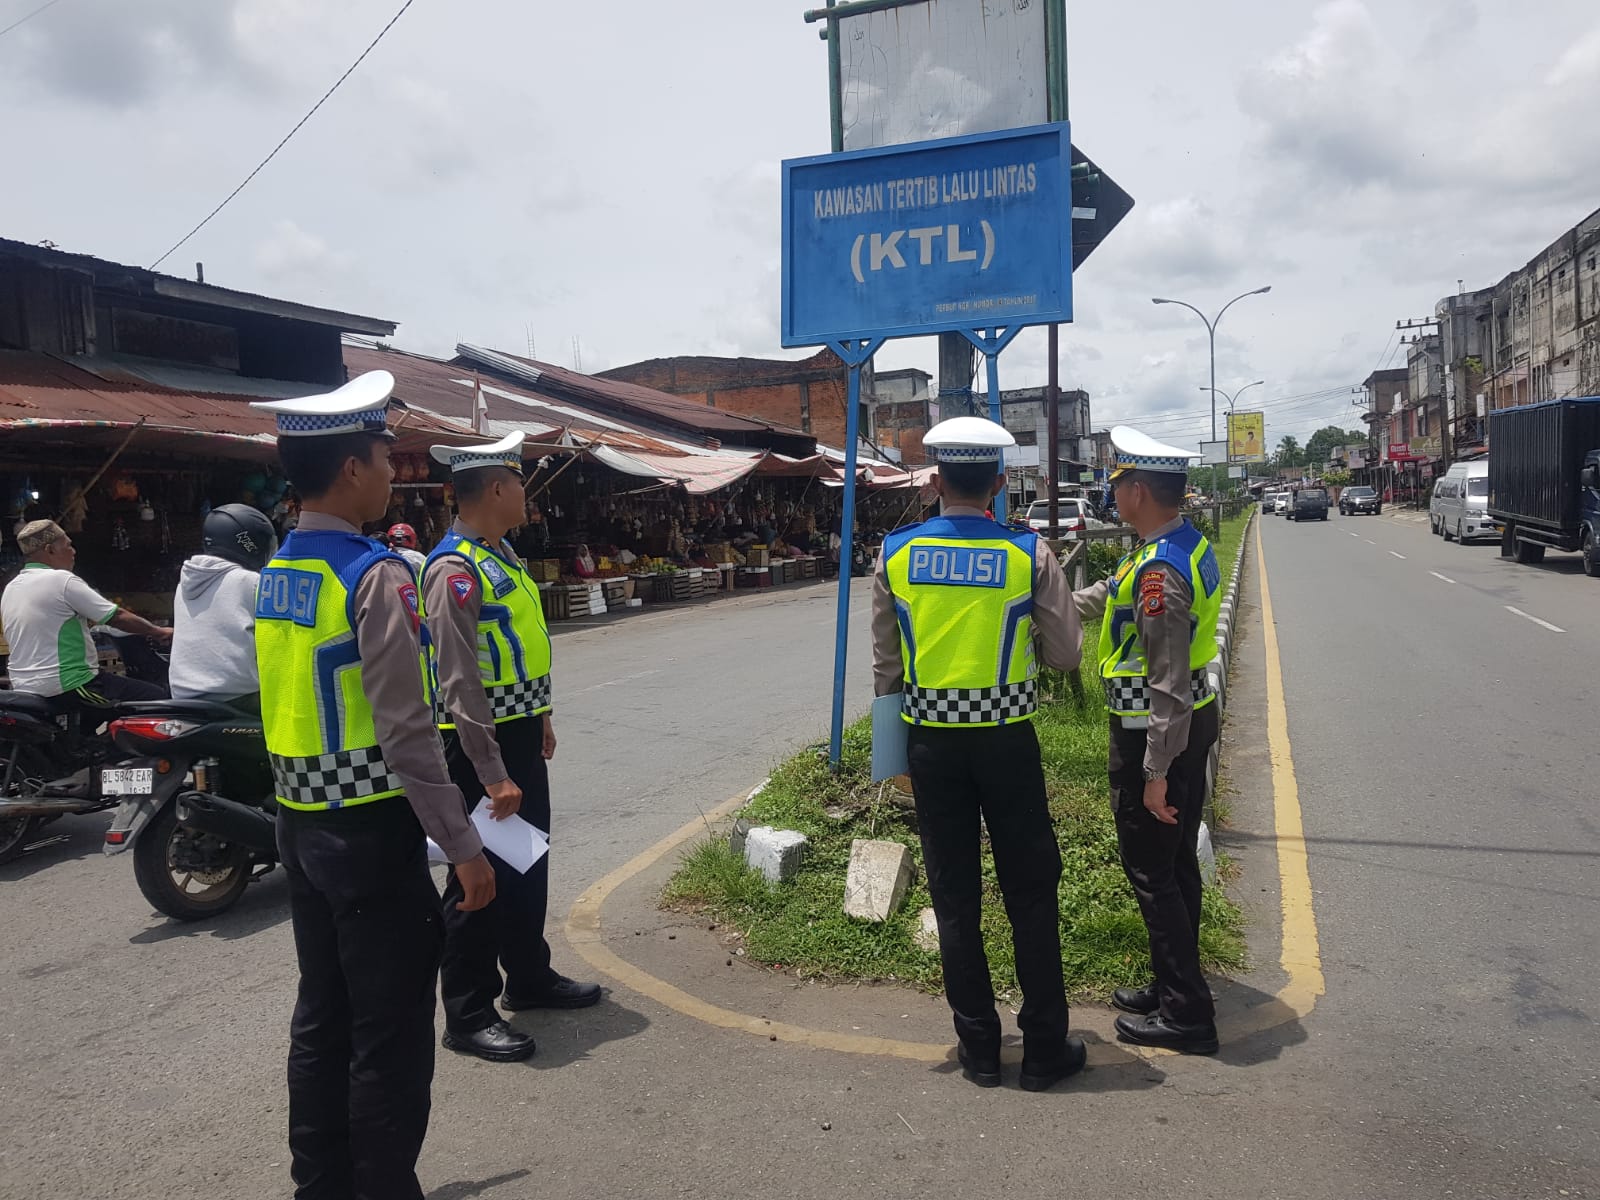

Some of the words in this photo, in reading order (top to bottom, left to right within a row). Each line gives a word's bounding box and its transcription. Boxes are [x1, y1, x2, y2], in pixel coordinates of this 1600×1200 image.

[815, 182, 883, 218] KAWASAN
[888, 175, 938, 209] TERTIB
[942, 170, 979, 203] LALU
[984, 163, 1036, 198] LINTAS
[851, 220, 995, 283] (KTL)
[912, 550, 1002, 584] POLISI
[259, 574, 316, 620] POSI
[103, 771, 112, 783] BL
[114, 770, 134, 782] 5842
[136, 769, 152, 782] EAR
